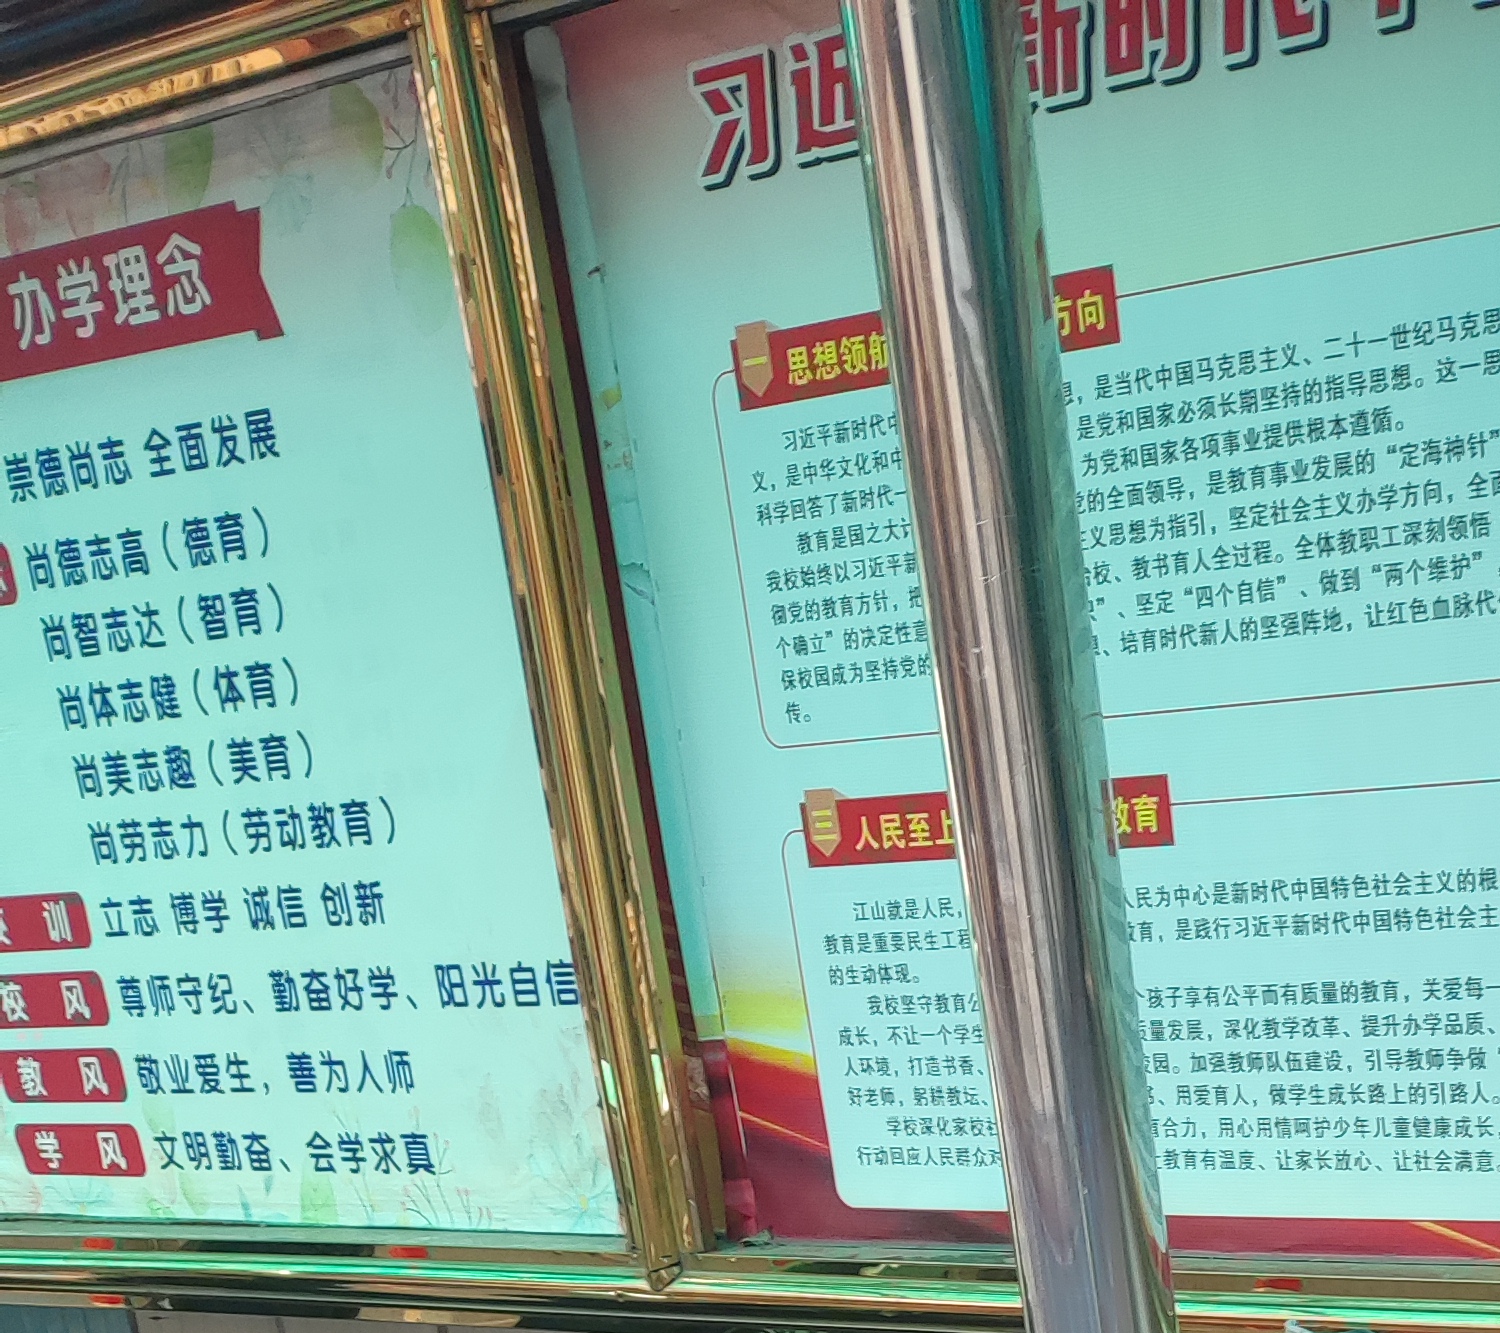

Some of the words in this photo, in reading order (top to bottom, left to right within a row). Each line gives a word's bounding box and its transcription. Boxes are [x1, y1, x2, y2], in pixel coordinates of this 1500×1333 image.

[6, 232, 212, 350] 办学理念
[3, 436, 133, 502] 崇德尚志
[142, 407, 280, 478] 全面发展
[102, 893, 160, 938] 立志
[168, 889, 231, 934] 博学
[243, 884, 305, 933] 诚信
[320, 880, 386, 929] 创新
